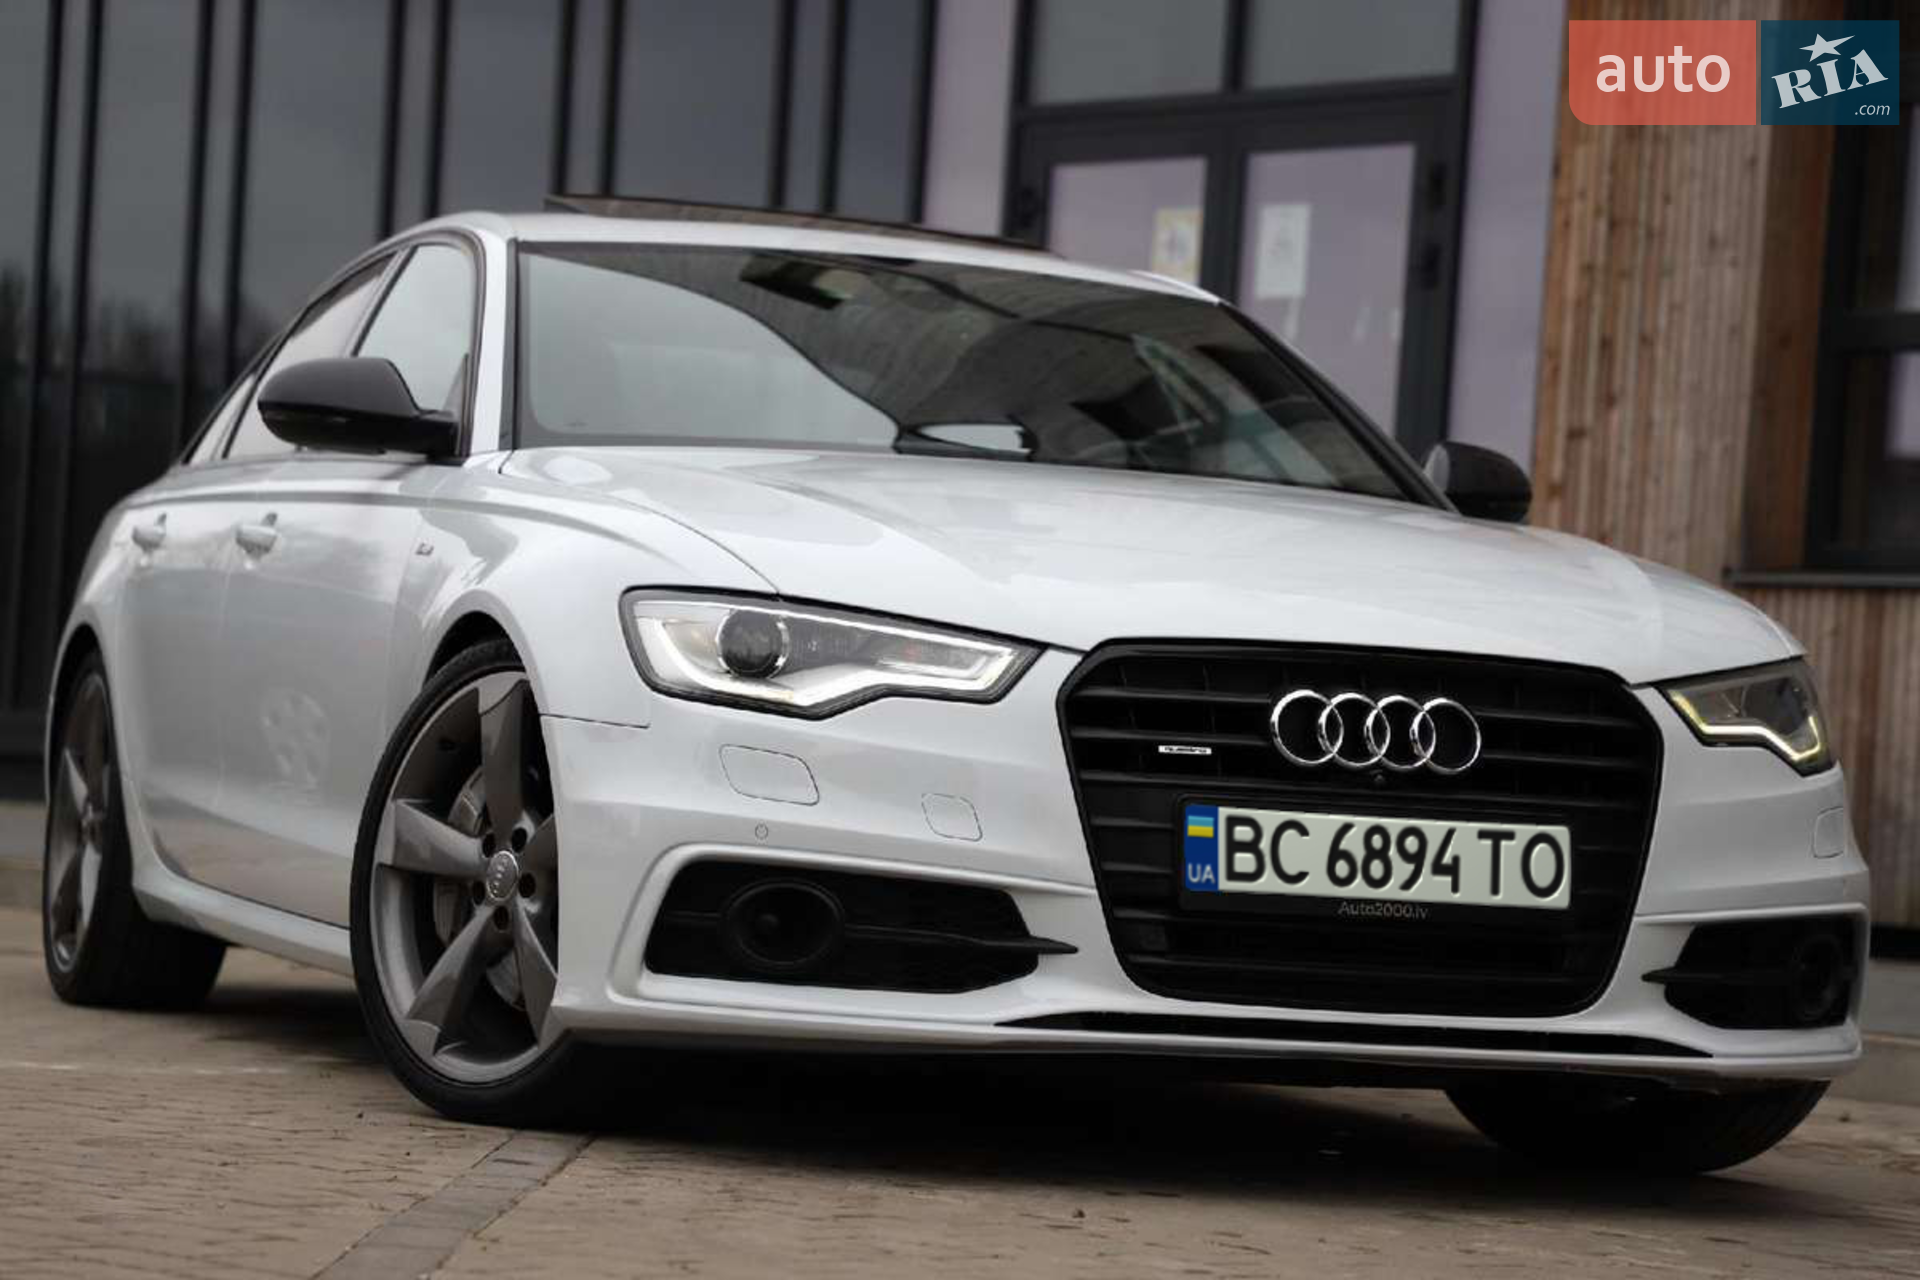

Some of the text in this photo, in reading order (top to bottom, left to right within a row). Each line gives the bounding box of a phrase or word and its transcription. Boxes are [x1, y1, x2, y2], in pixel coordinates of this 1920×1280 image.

[1187, 863, 1215, 884] UA
[1225, 815, 1564, 898] BC 6894 TO
